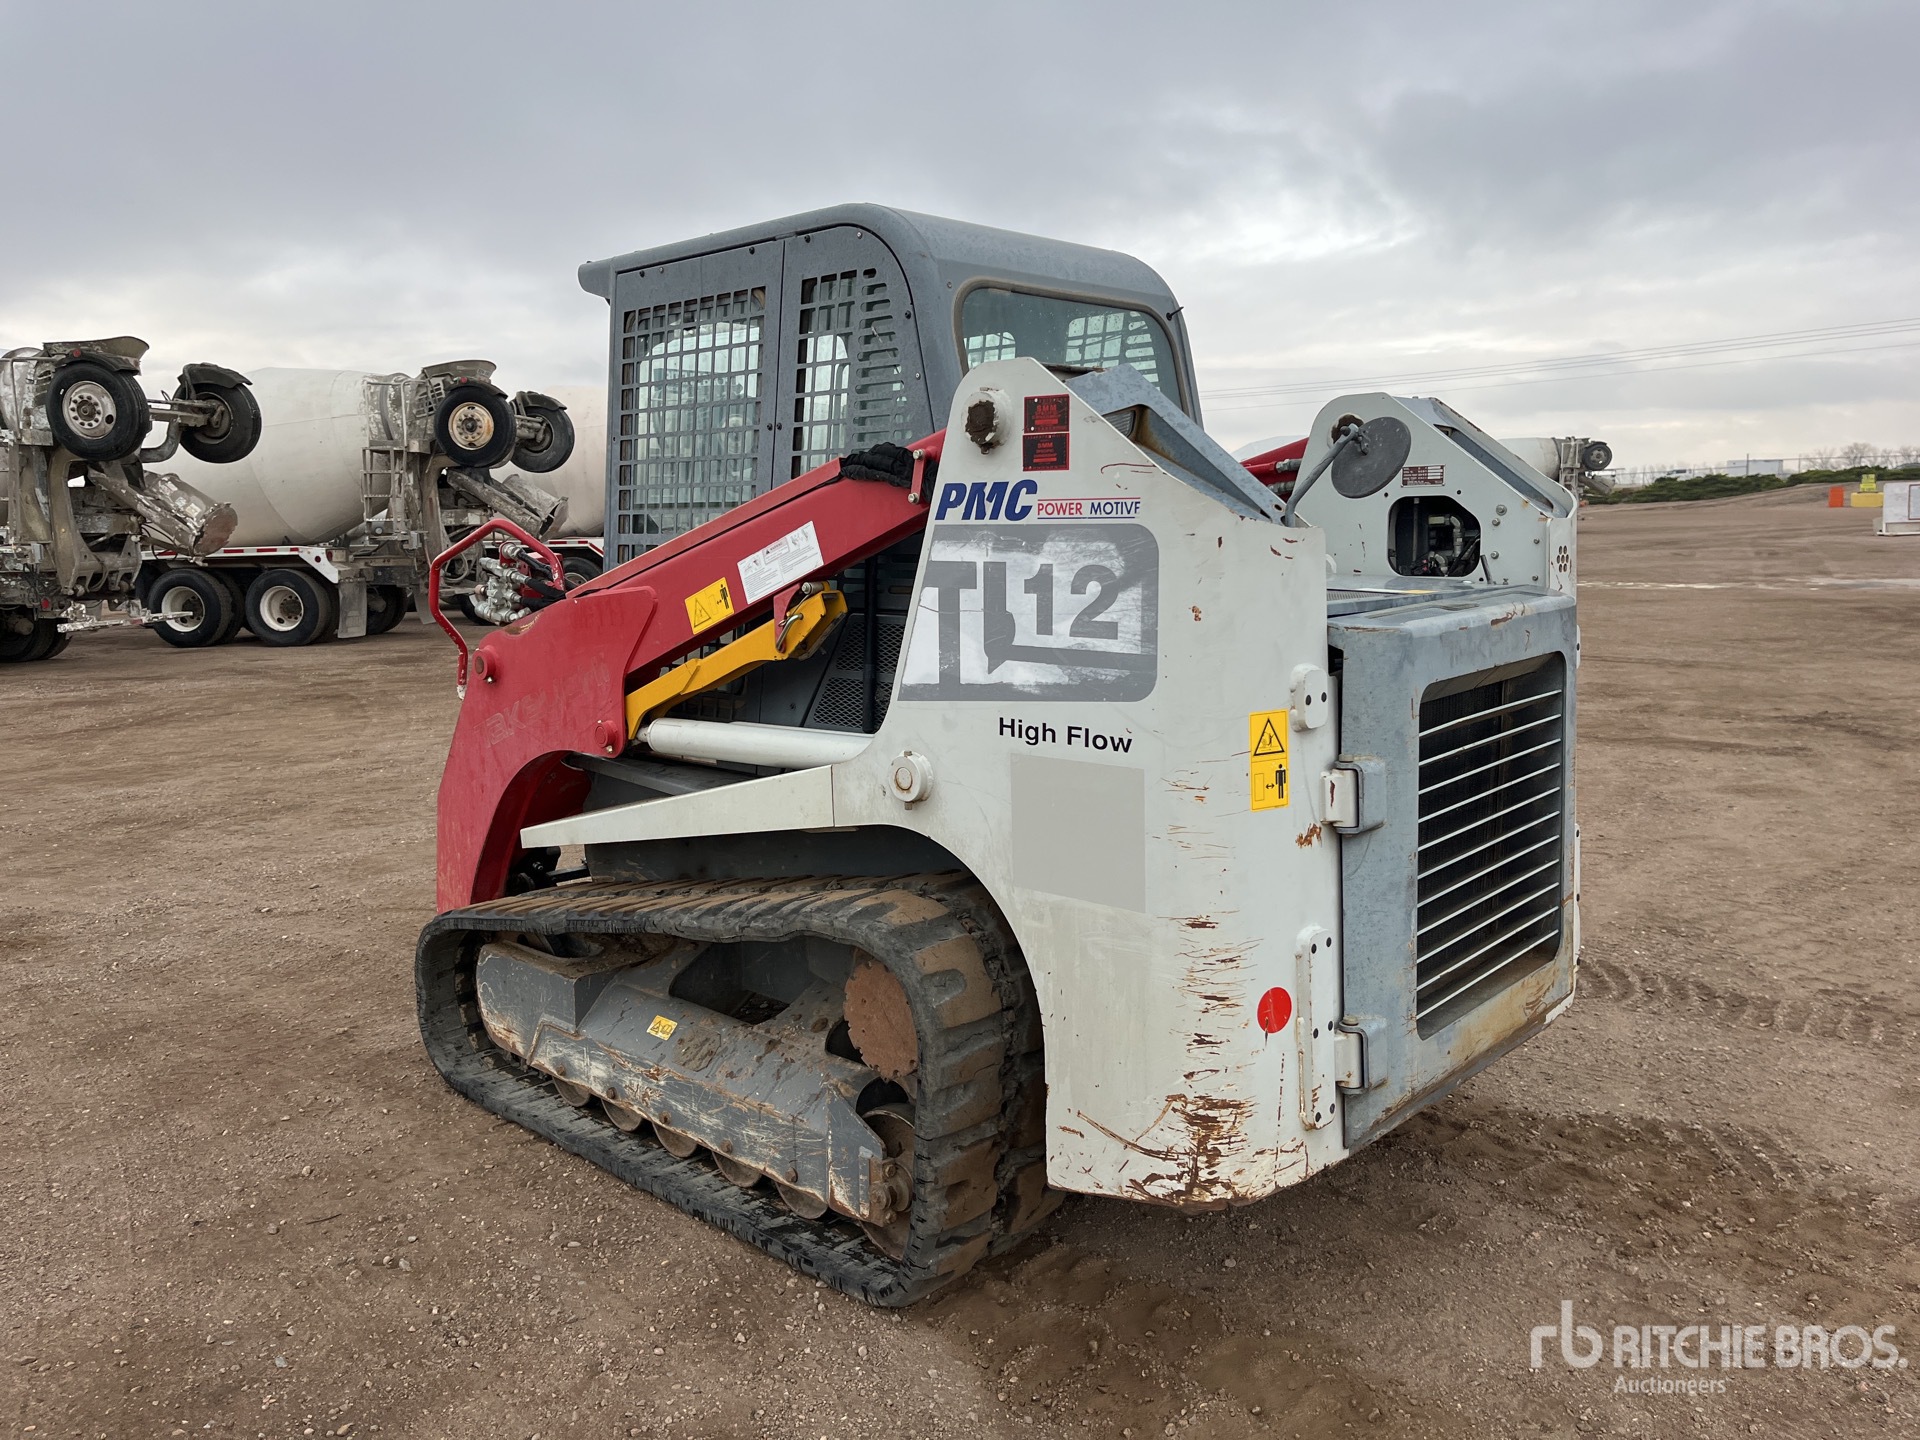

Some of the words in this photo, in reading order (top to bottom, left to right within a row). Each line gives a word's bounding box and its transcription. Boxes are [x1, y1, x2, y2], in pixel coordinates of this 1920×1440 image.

[936, 480, 1037, 521] PMC
[1037, 502, 1083, 516] POWER
[999, 717, 1056, 744] High
[1067, 726, 1133, 752] Flow
